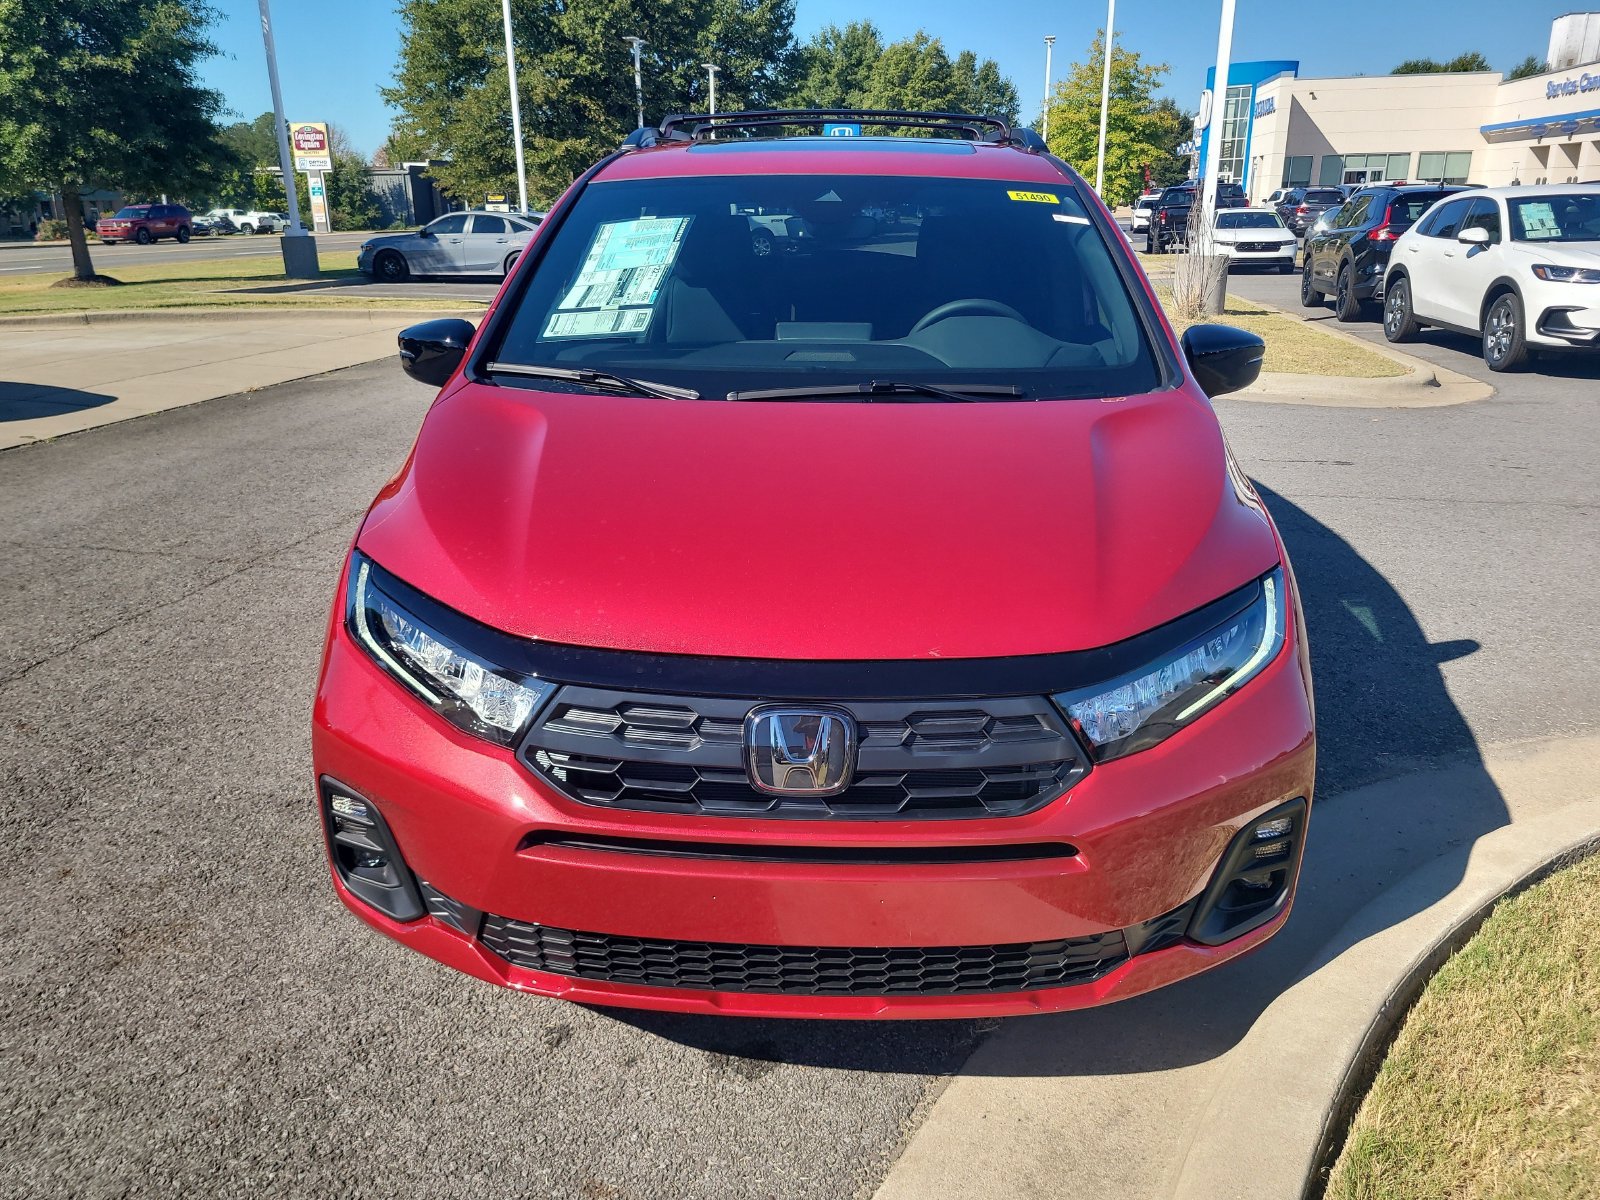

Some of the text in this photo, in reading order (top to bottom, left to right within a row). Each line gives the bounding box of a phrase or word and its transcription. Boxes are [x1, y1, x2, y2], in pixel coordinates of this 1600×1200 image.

[1546, 80, 1577, 97] Service
[295, 132, 323, 141] Covington
[300, 140, 321, 150] Square
[1016, 193, 1050, 202] 51490
